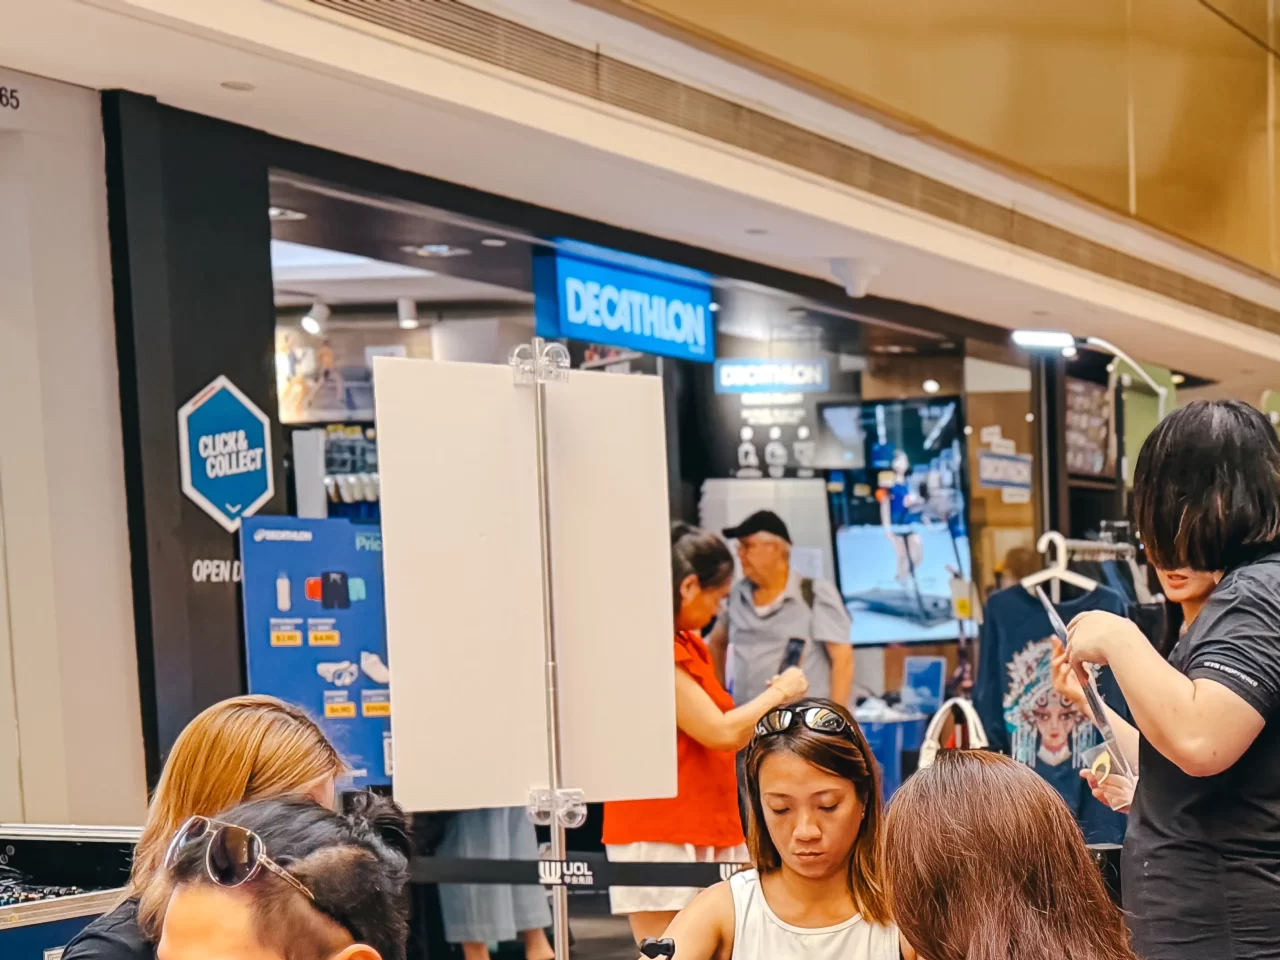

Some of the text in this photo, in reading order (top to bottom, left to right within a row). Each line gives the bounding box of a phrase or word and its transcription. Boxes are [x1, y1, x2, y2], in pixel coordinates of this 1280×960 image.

[565, 277, 706, 346] DECATHLON
[206, 448, 263, 479] COLLECT
[192, 559, 231, 582] OPEN
[563, 862, 593, 875] UOL
